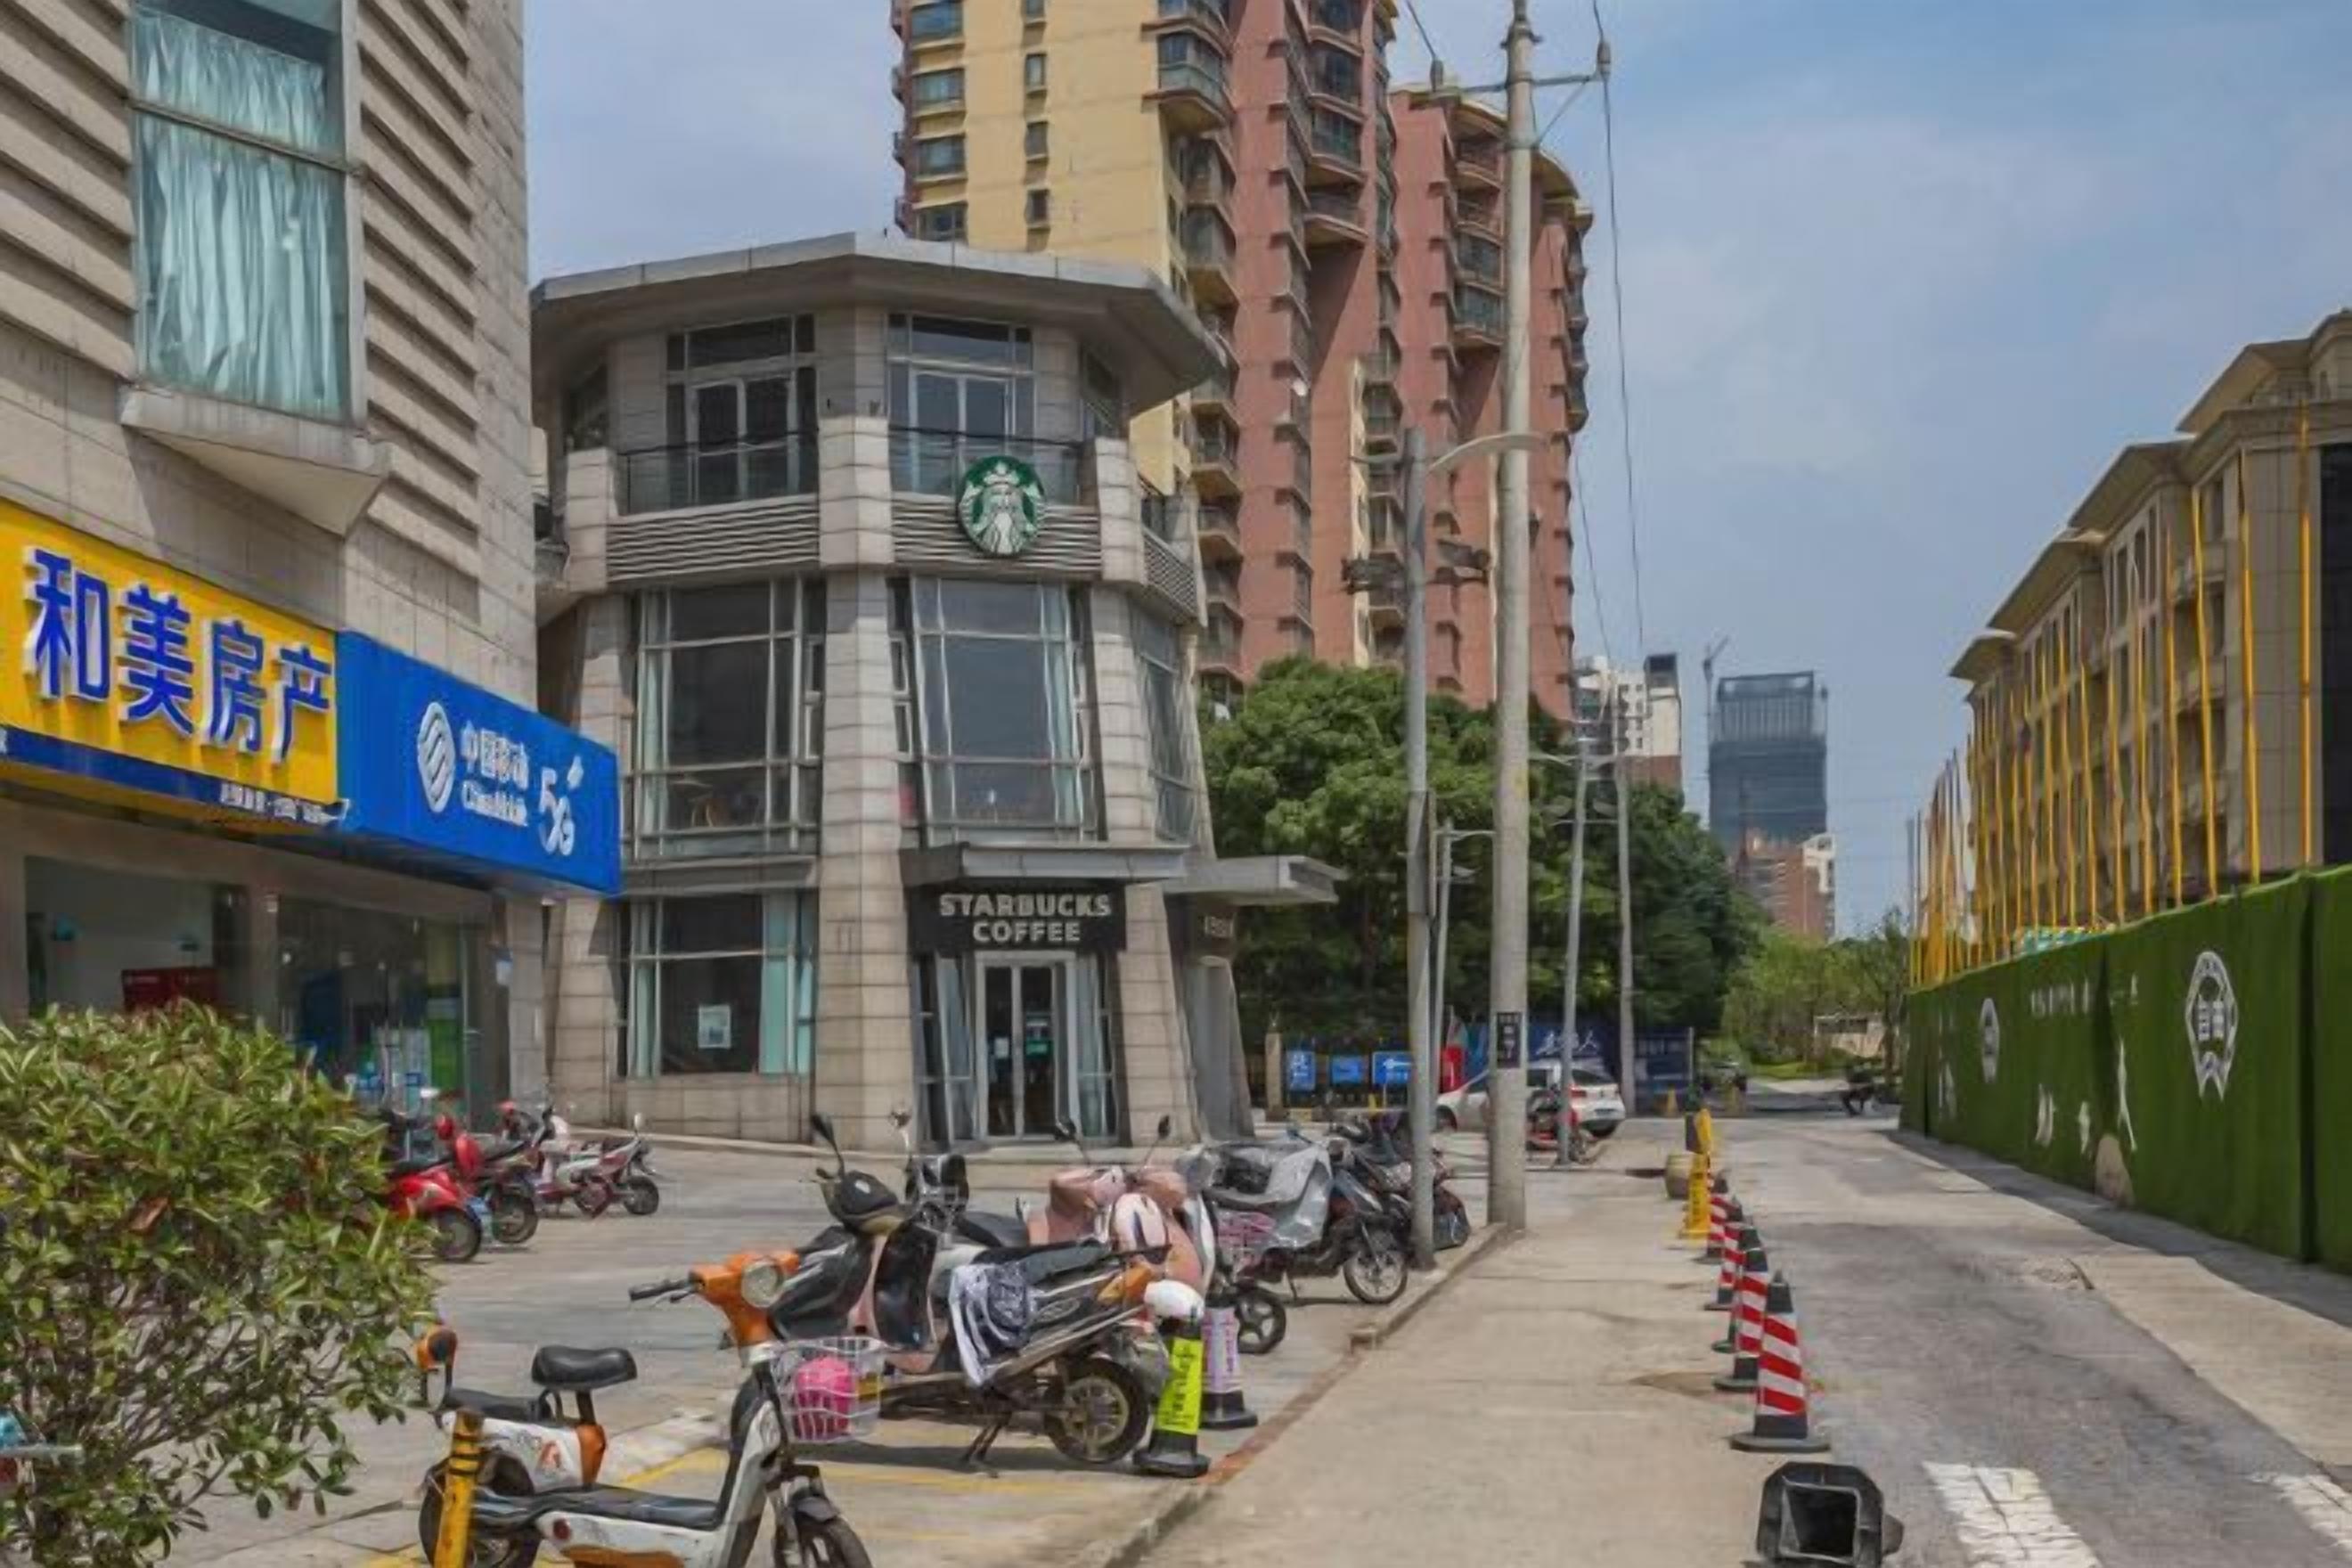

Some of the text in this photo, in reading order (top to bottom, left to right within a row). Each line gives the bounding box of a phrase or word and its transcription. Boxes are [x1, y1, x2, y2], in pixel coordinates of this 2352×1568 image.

[24, 545, 332, 764] 和美房产
[939, 893, 1112, 917] STARBUCKS
[973, 920, 1081, 943] COFFEE
